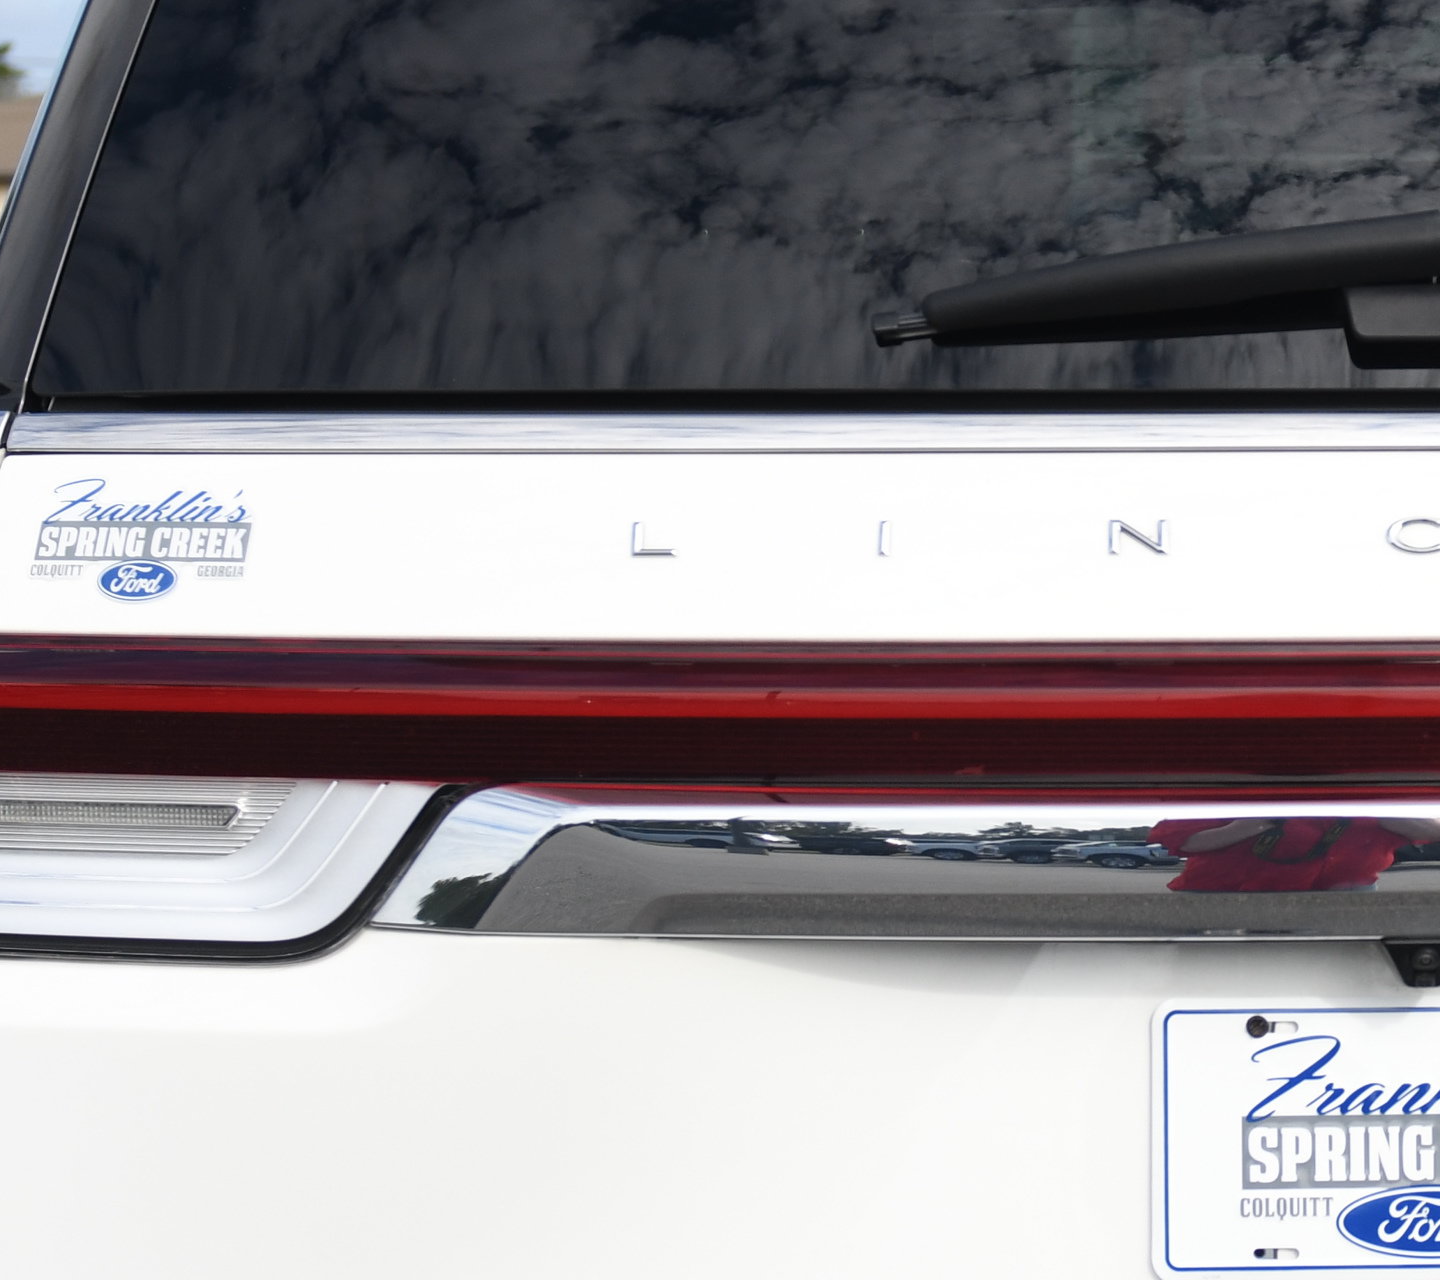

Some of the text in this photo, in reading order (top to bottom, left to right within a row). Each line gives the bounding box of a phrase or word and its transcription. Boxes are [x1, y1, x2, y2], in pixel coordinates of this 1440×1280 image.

[42, 478, 252, 524] Franklin's
[38, 526, 248, 559] SPRING CREEK
[29, 564, 84, 579] COLQUITT
[110, 564, 165, 593] Ford
[196, 565, 245, 578] GEORGIA
[1247, 1124, 1437, 1184] SPRING
[1239, 1196, 1335, 1221] COLQUITT
